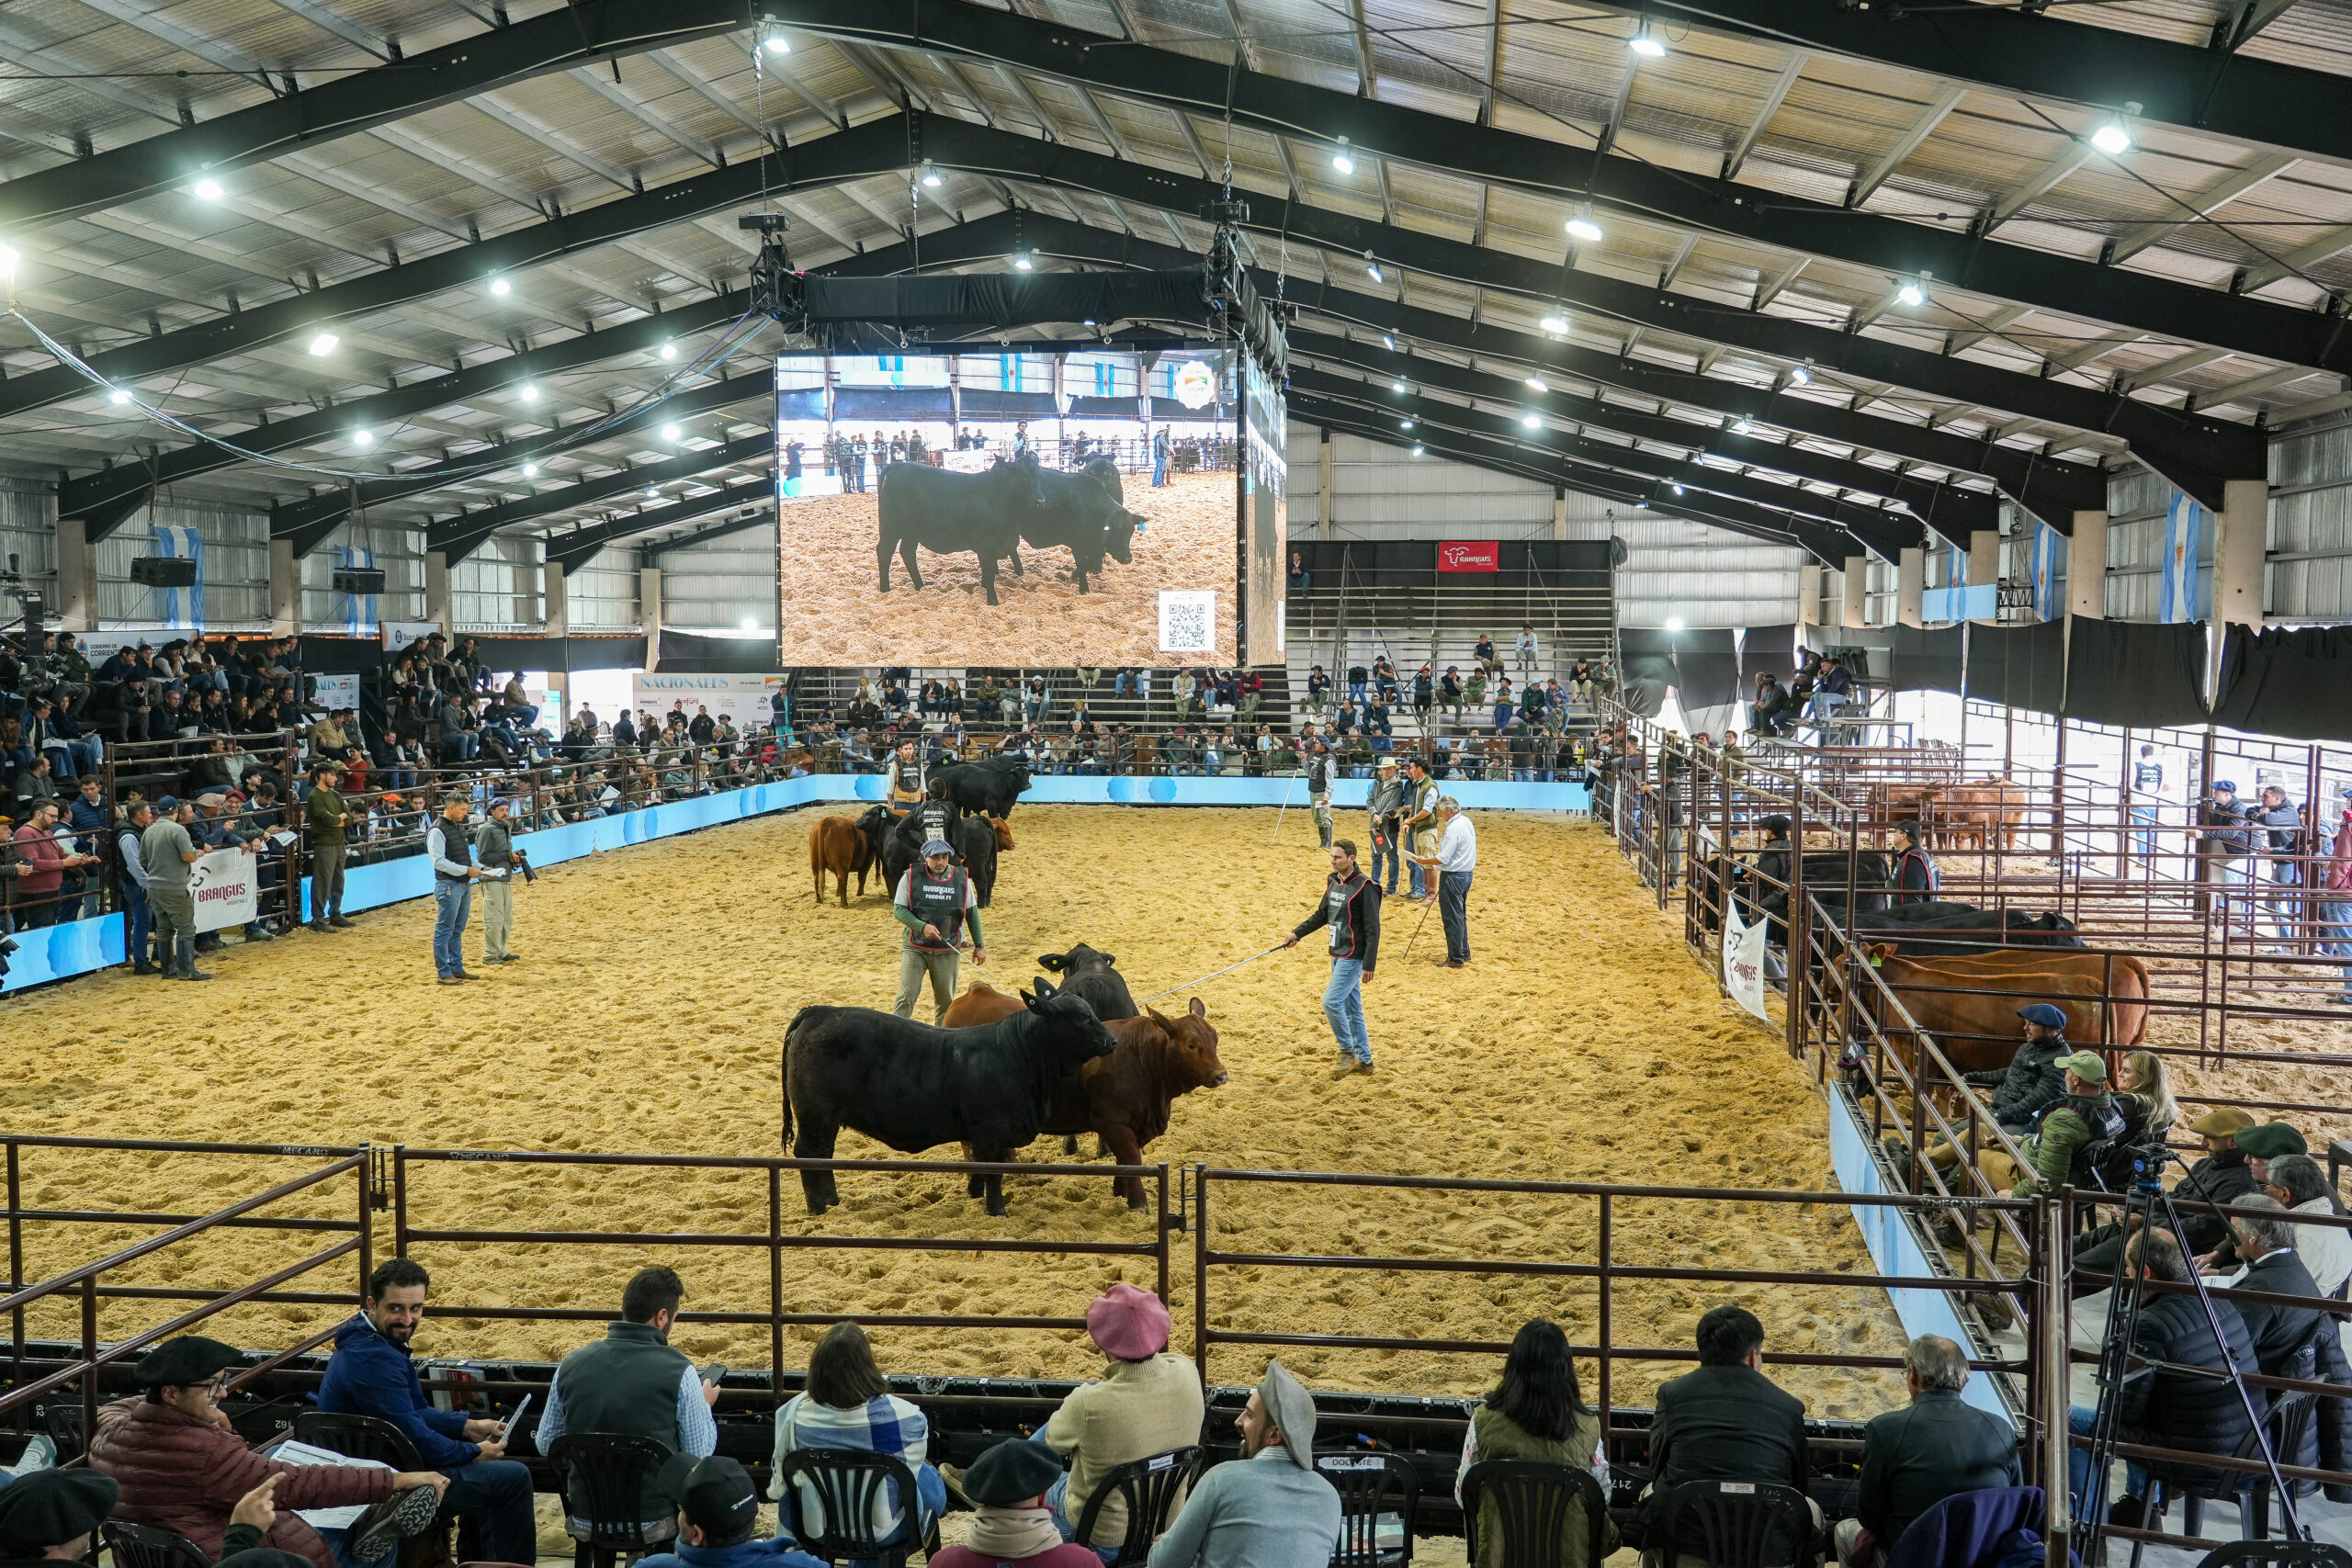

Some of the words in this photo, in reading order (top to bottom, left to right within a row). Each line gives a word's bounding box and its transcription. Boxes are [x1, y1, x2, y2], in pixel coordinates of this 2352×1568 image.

[640, 677, 729, 689] NACIONALES
[198, 883, 246, 902] BRANGUS
[922, 885, 956, 894] BRANGUS
[282, 1145, 329, 1156] MECANO
[460, 1152, 510, 1162] MECANO
